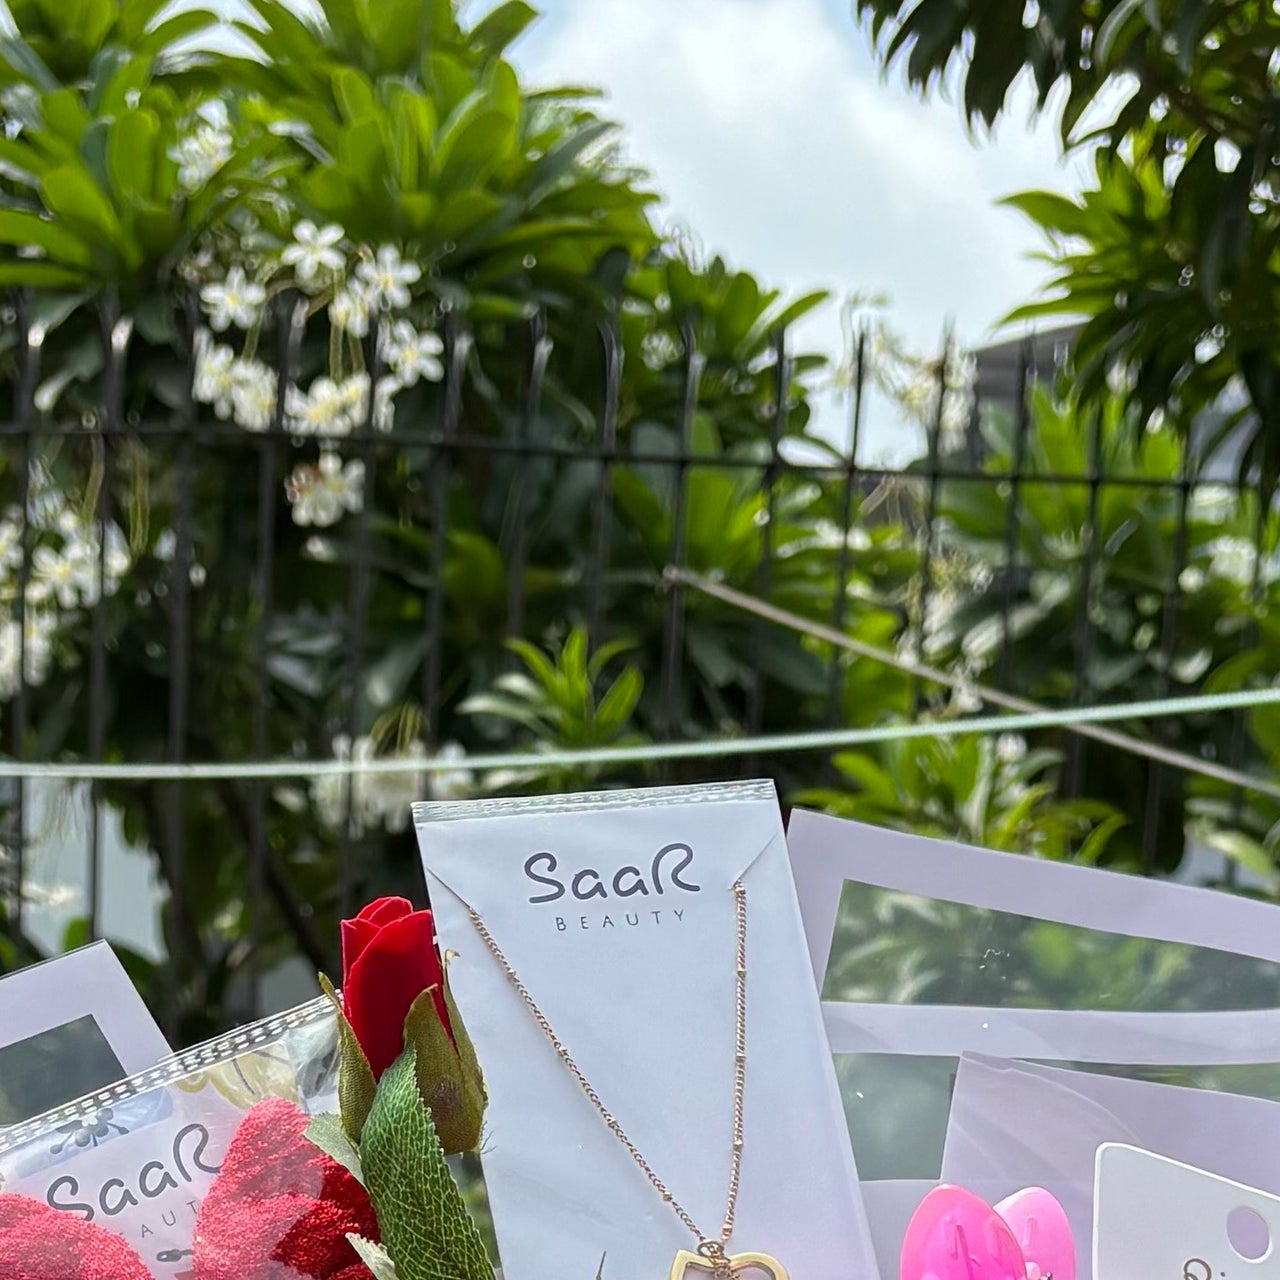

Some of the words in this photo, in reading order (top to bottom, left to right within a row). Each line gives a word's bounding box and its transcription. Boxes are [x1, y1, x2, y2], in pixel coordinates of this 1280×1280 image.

[524, 842, 701, 904] SaaR
[556, 909, 685, 932] BEAUTY
[47, 1123, 221, 1222] SaaR
